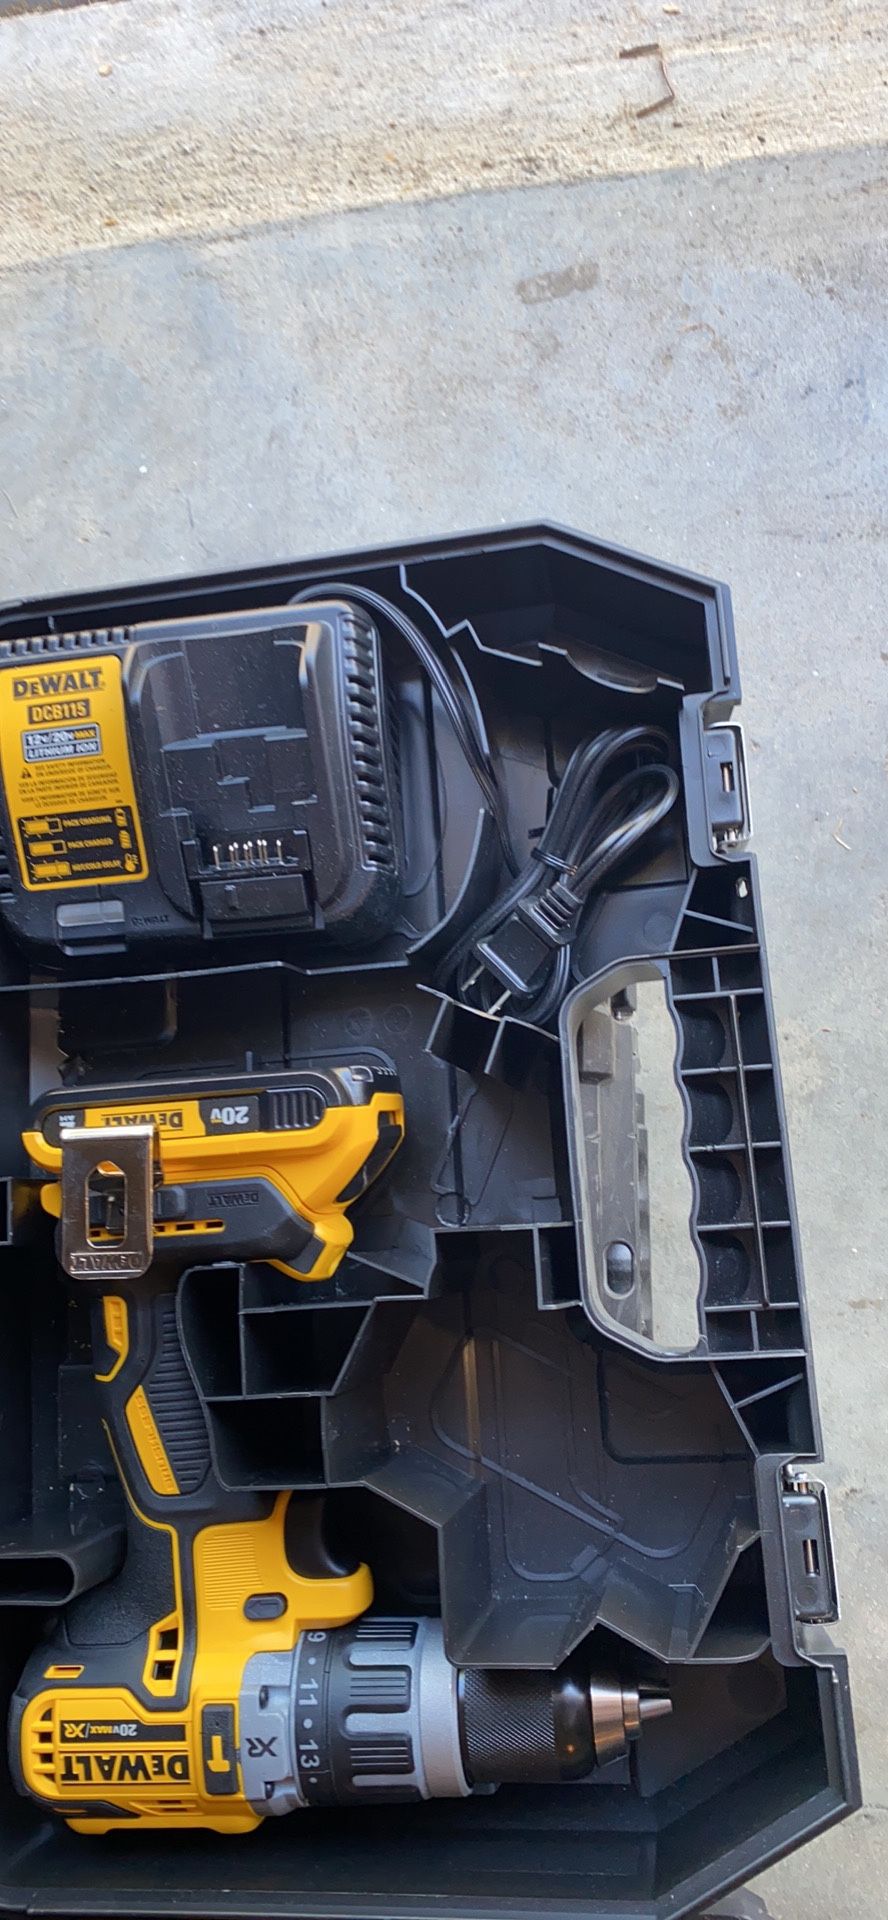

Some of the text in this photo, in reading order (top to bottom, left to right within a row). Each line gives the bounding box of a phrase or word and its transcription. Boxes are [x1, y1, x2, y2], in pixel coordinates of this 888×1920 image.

[32, 701, 87, 721] DCB115
[28, 741, 98, 759] LITHIUM ION
[299, 1678, 319, 1706] 11
[245, 1736, 278, 1757] XR
[299, 1739, 320, 1768] 13
[60, 1754, 190, 1781] DEWALT
